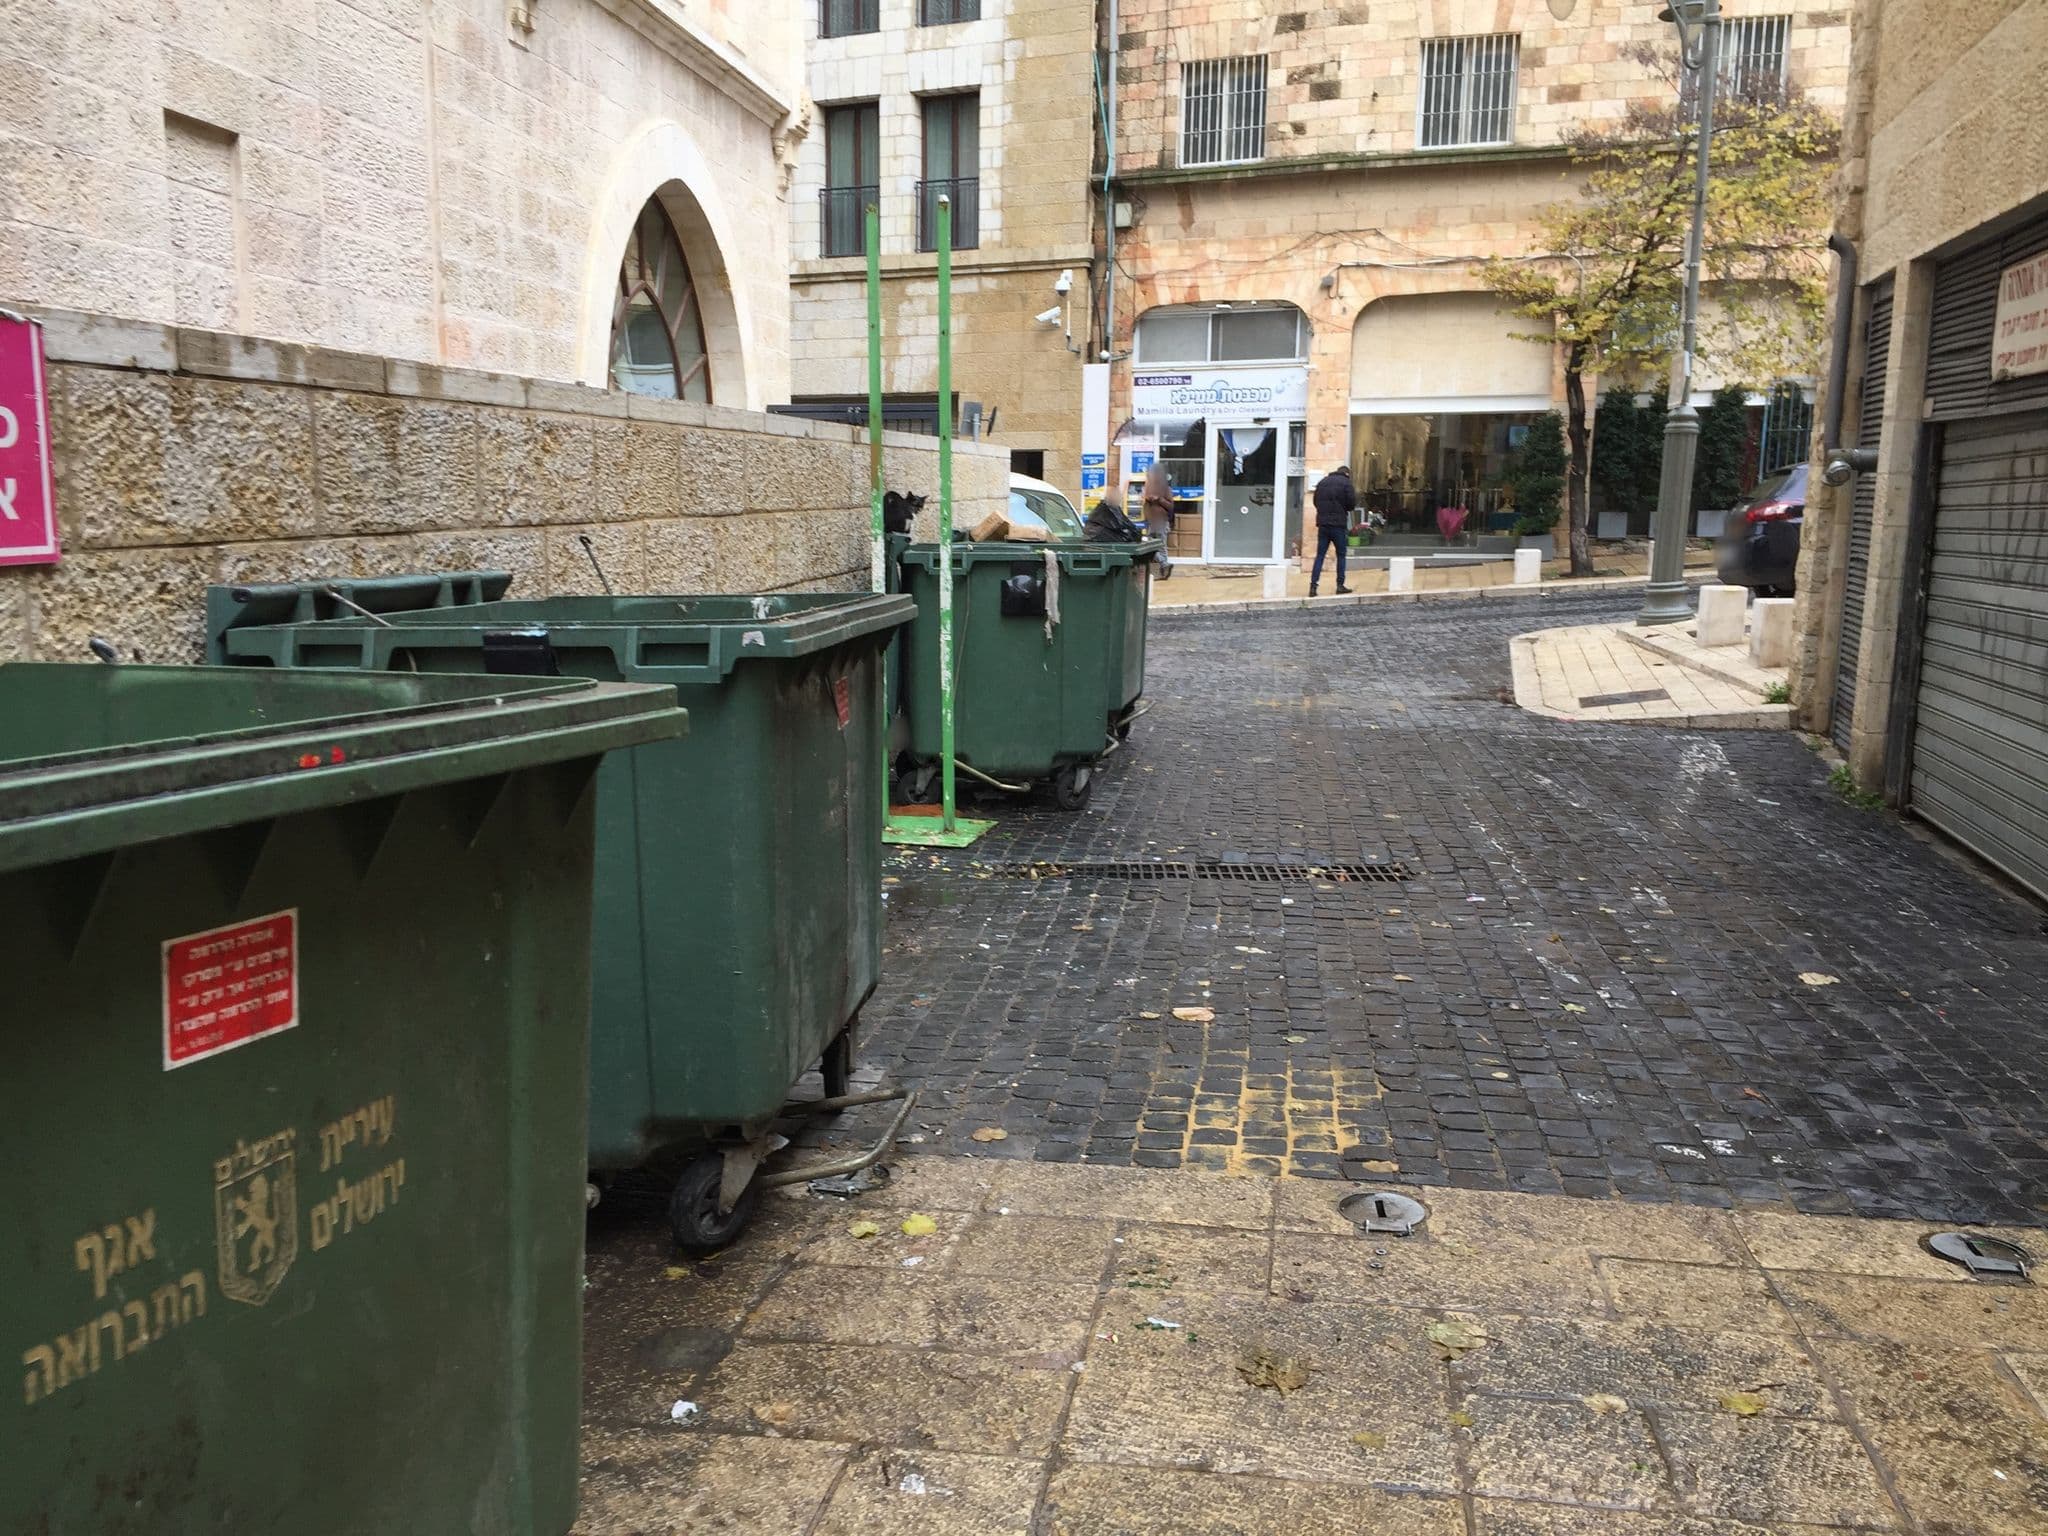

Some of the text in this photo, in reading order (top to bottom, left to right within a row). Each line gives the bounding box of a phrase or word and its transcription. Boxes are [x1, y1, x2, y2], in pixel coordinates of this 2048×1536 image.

[1137, 407, 1174, 415] Mamilla
[1176, 406, 1216, 415] Laundry
[311, 1158, 405, 1251] ירושלים
[74, 1207, 156, 1298] אגף
[23, 1268, 206, 1405] התברואה
